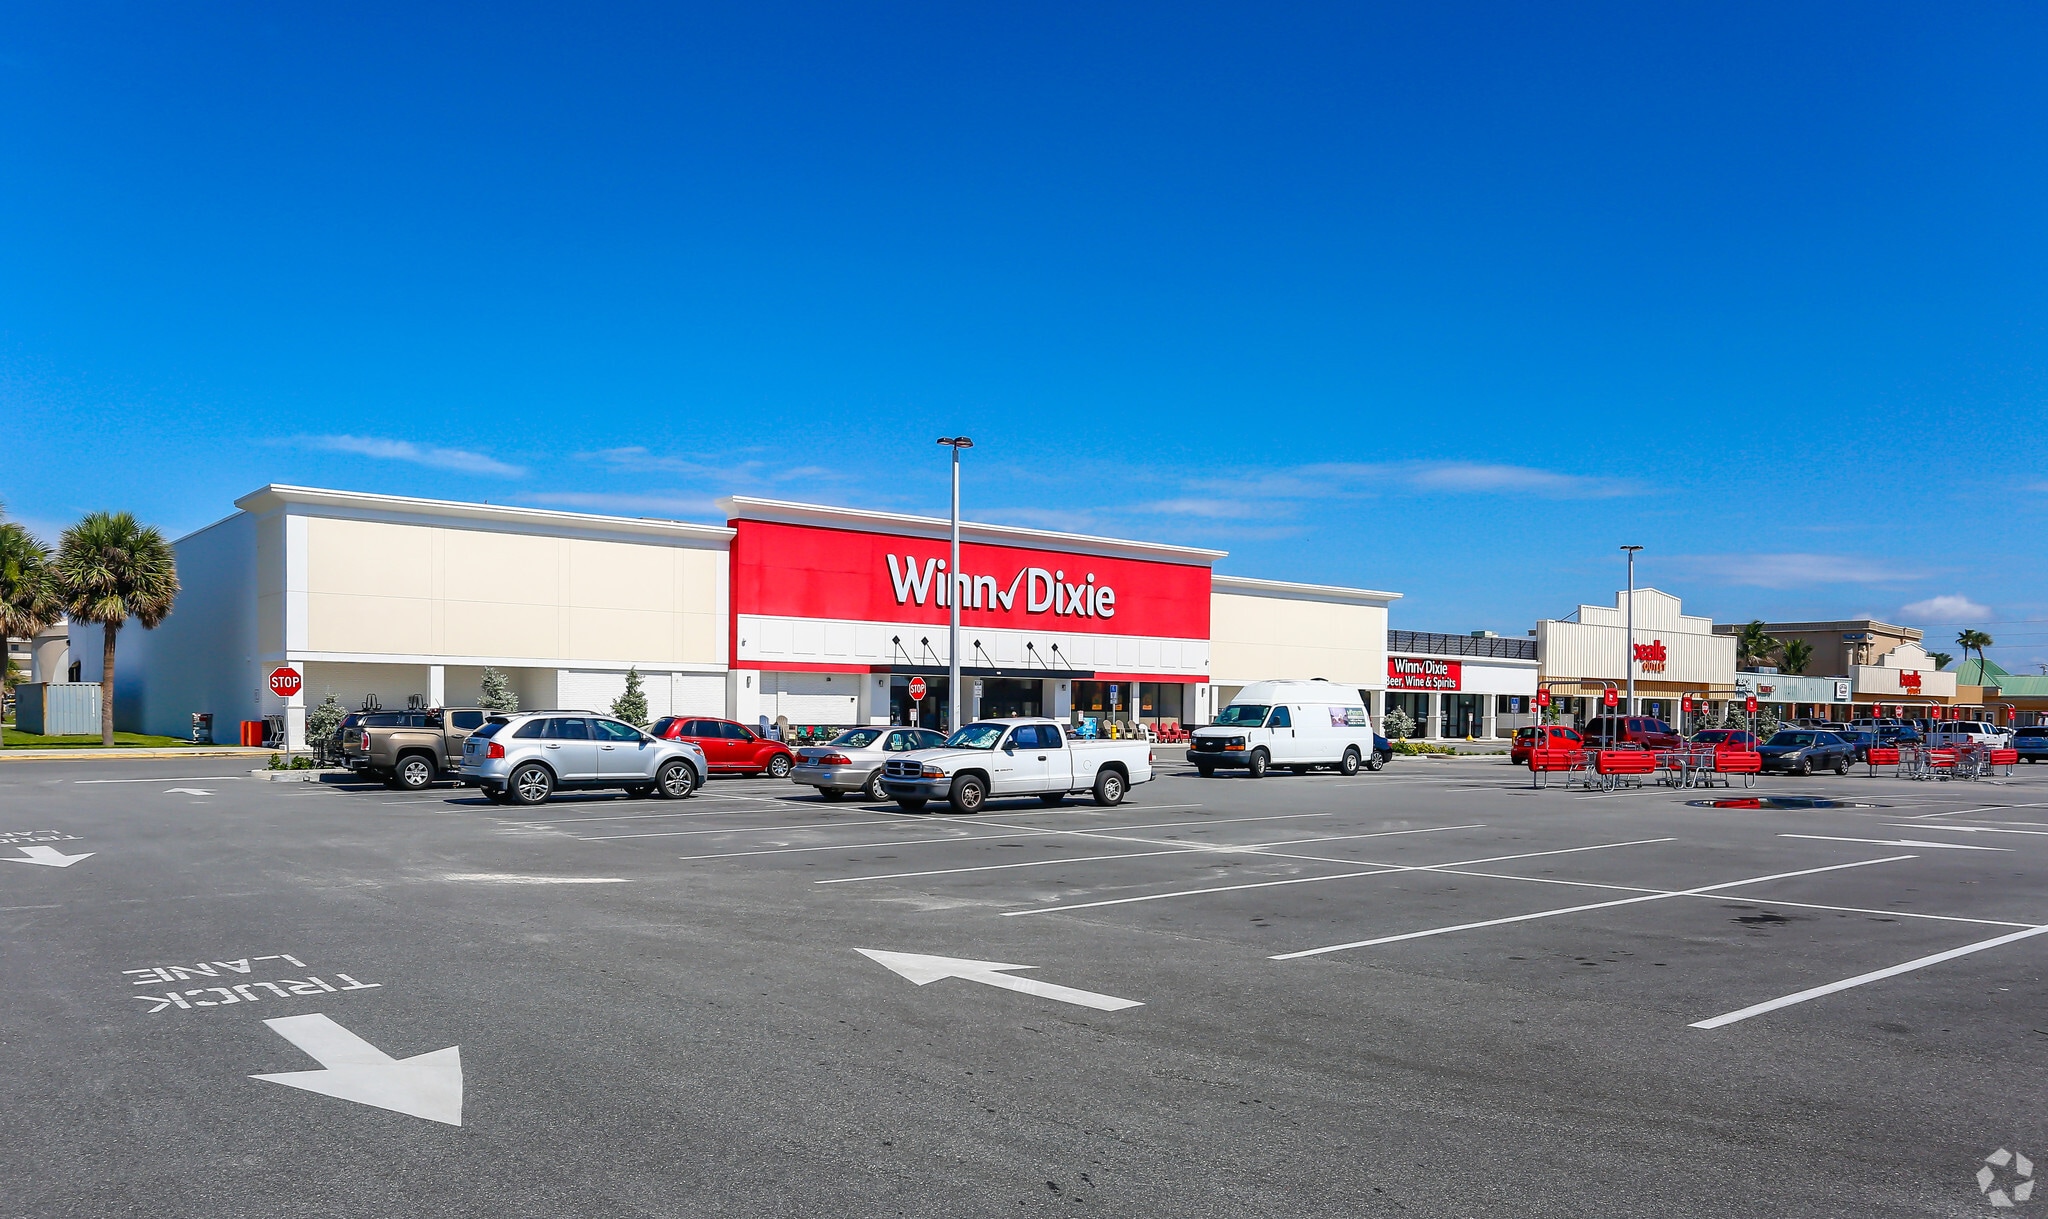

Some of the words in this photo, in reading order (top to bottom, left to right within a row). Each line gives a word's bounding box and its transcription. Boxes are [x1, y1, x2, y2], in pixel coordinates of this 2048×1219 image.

[886, 553, 997, 610] Winn
[1027, 567, 1116, 618] Dixie
[1394, 658, 1420, 674] Winn
[1425, 660, 1448, 675] Dixie
[271, 676, 300, 688] STOP
[910, 684, 926, 694] STOP
[1386, 674, 1404, 688] Beer,
[1405, 675, 1425, 687] Wine
[1425, 676, 1432, 688] &
[1432, 676, 1457, 691] Spirits
[122, 954, 307, 985] LANE
[133, 973, 383, 1014] TRUCK
